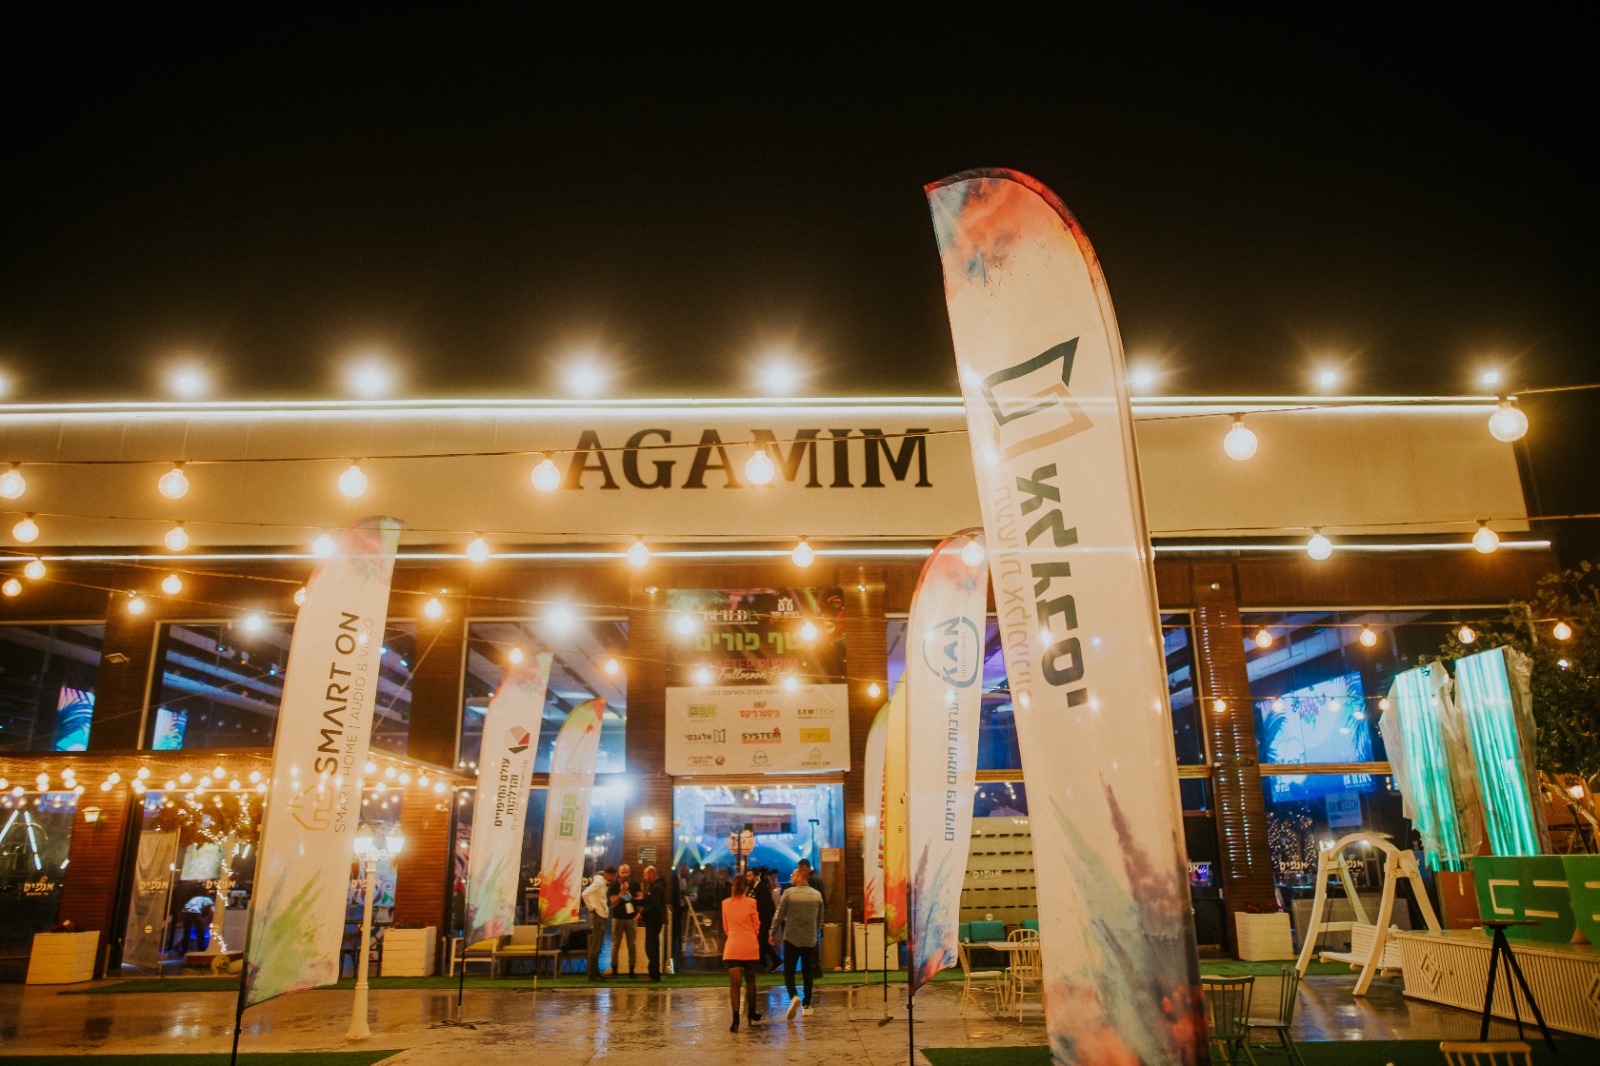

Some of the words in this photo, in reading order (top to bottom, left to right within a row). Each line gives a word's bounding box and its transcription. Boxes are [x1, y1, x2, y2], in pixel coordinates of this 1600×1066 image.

[562, 429, 933, 490] AGAMIM
[695, 632, 761, 652] פורים
[942, 616, 961, 681] KAN
[314, 662, 352, 776] SMART
[335, 611, 360, 655] ON
[342, 735, 358, 776] HOME
[351, 677, 366, 720] AUDIO
[741, 732, 781, 740] SYSTEM
[499, 758, 510, 782] עולם
[946, 747, 958, 785] חימום
[494, 784, 507, 827] החיפויים
[944, 790, 957, 842] פרימיום
